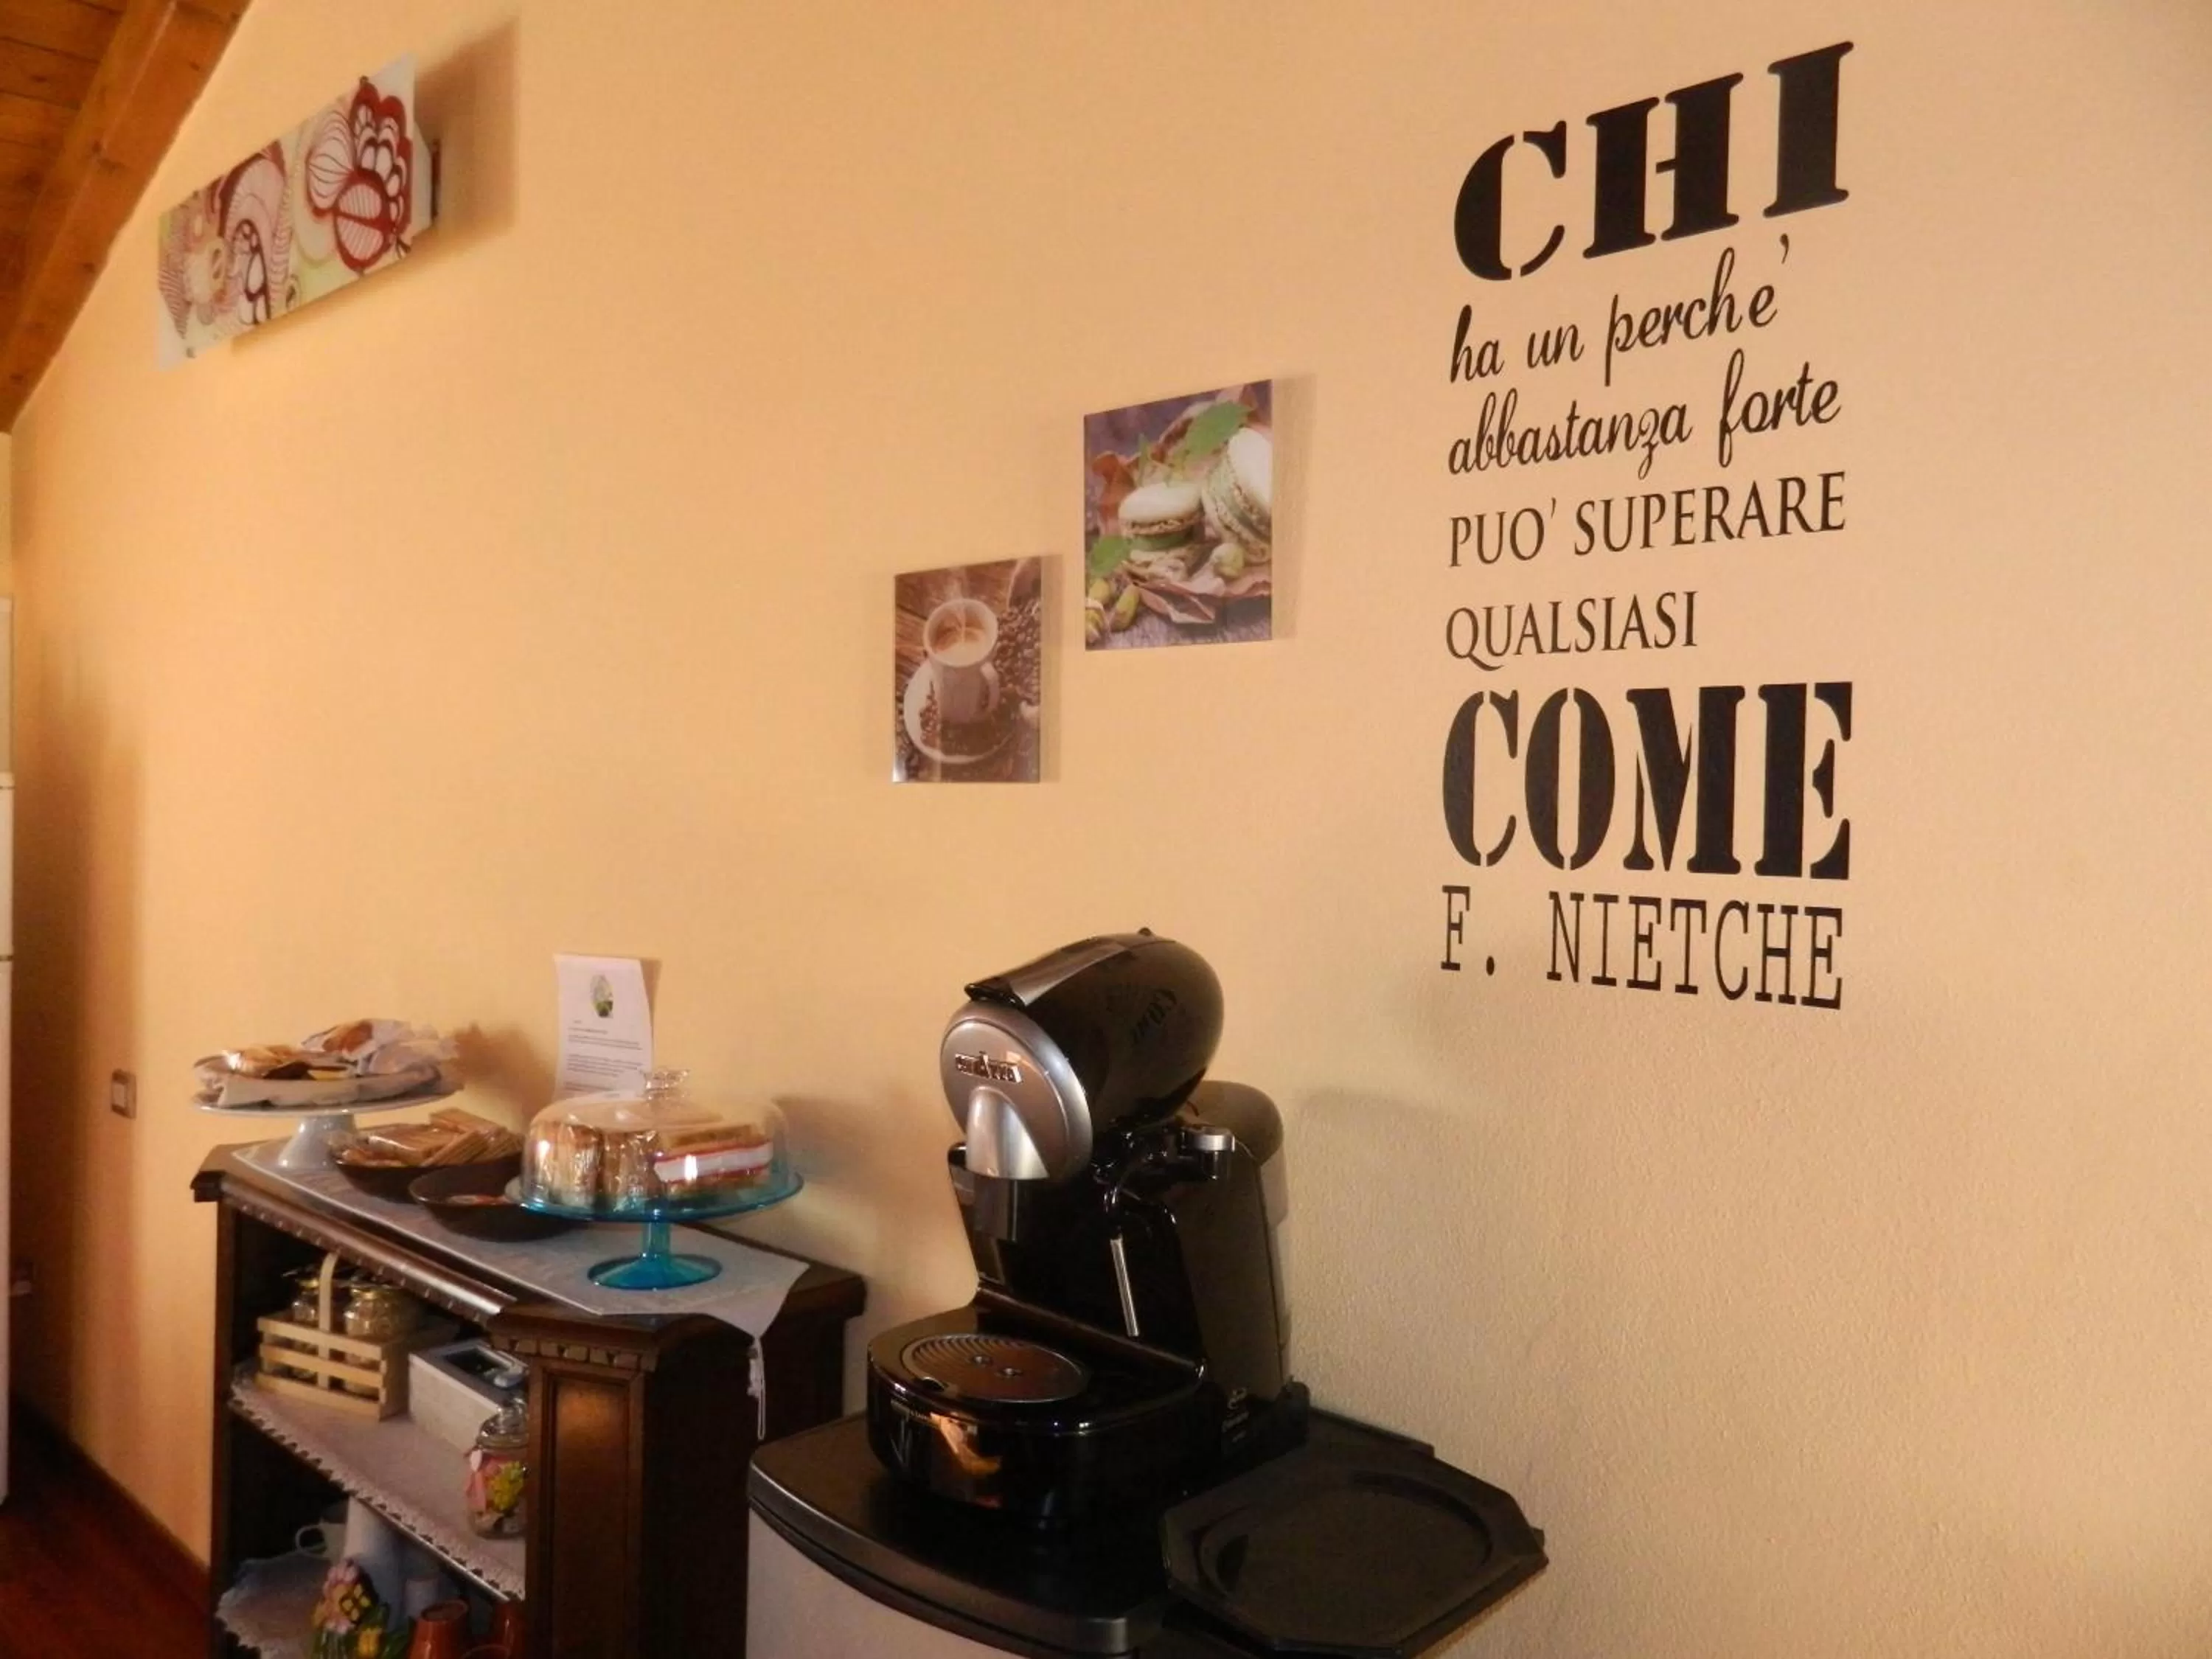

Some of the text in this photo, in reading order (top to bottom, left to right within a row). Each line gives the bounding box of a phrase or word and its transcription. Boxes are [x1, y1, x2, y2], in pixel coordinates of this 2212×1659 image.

[1453, 41, 1855, 281] CHI
[1450, 305, 1504, 383] ha
[1526, 324, 1585, 369] un
[1449, 348, 1843, 479] abbastanza forte
[1450, 471, 1846, 568] PUO' SUPERARE
[1446, 591, 1698, 672] QUALSIASI
[1442, 681, 1854, 880] COME
[1441, 885, 1843, 1011] F. NIETCHE
